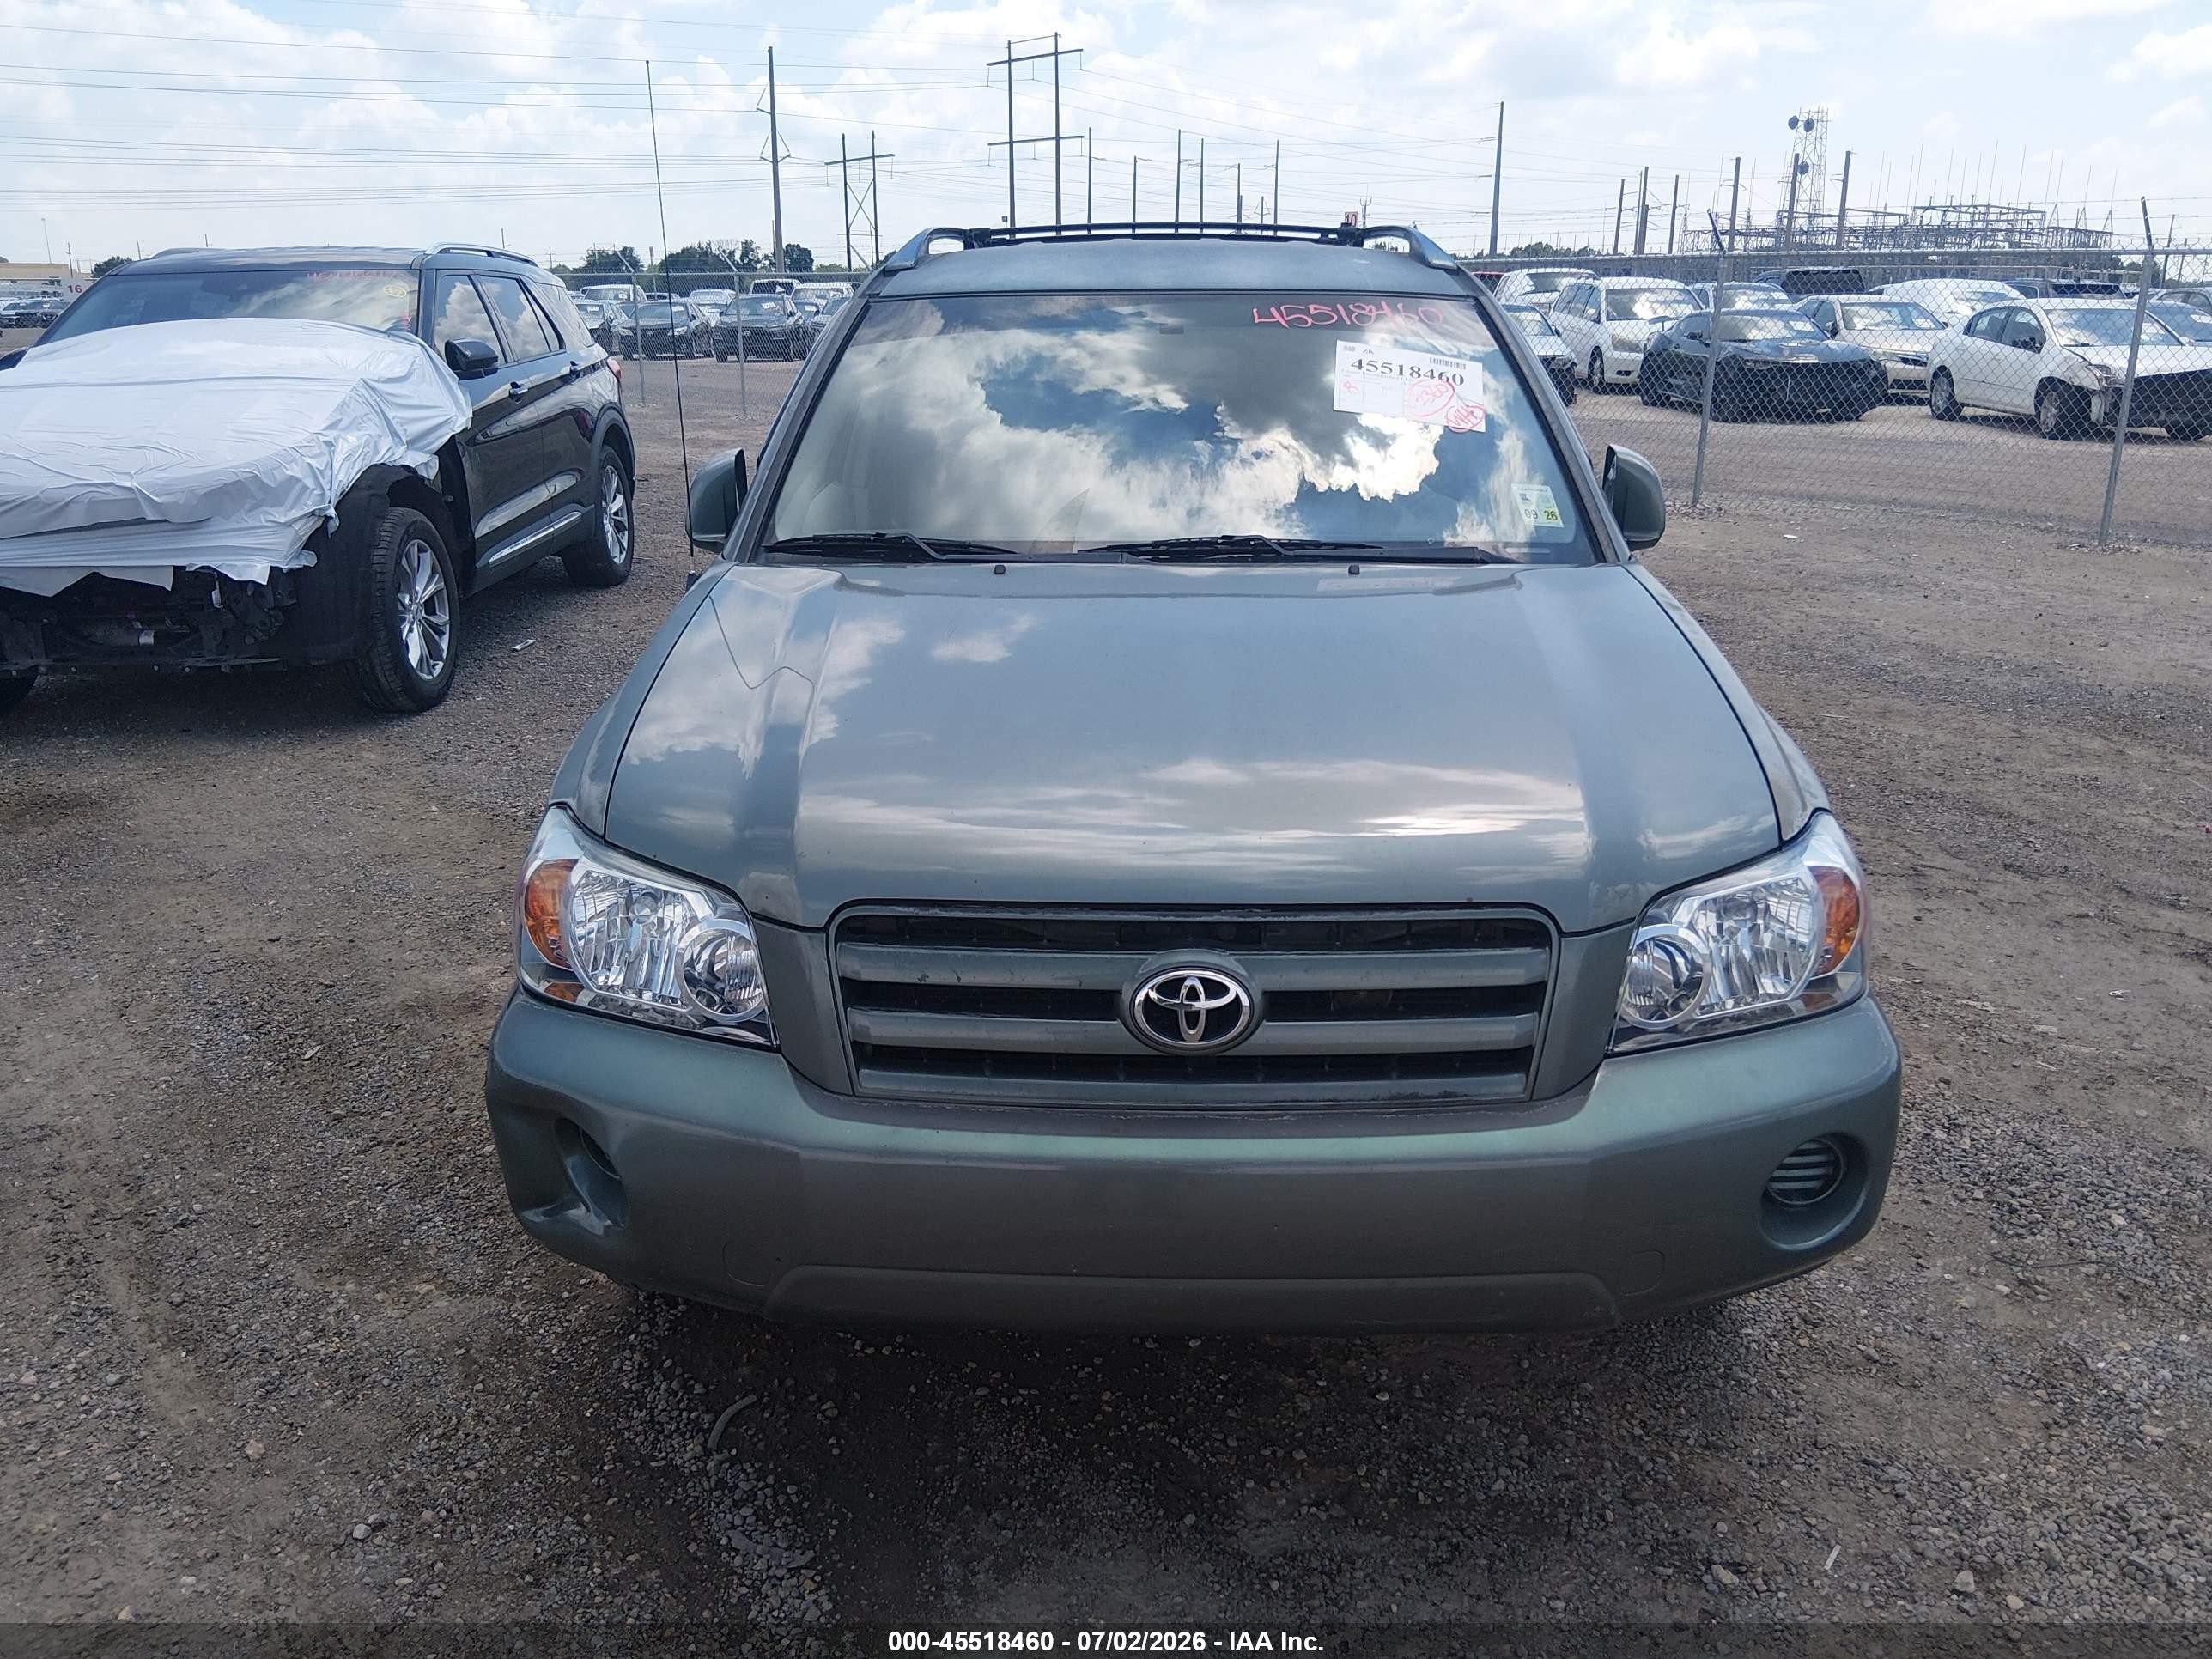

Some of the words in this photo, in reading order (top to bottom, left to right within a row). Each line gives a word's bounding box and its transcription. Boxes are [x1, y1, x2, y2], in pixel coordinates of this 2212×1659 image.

[1345, 213, 1357, 228] 10
[68, 284, 82, 294] 16
[1253, 301, 1443, 329] 45518460
[1351, 358, 1465, 386] 45518460
[1524, 508, 1539, 520] 09
[1543, 510, 1559, 521] 26
